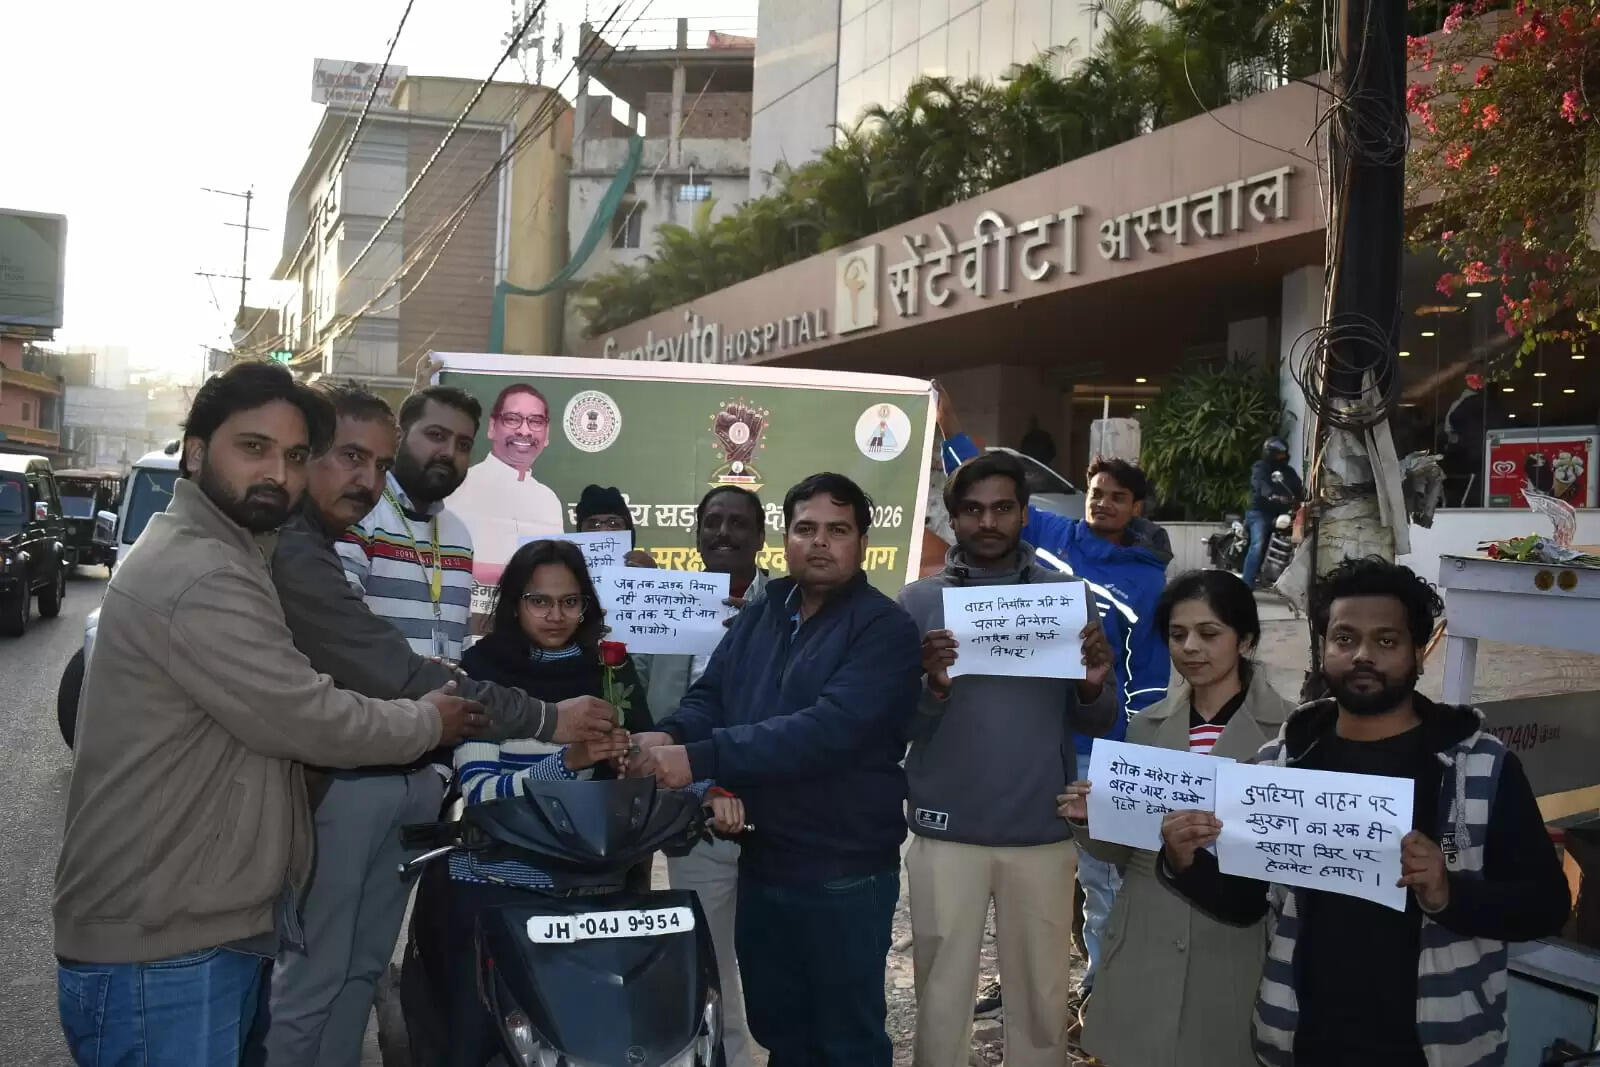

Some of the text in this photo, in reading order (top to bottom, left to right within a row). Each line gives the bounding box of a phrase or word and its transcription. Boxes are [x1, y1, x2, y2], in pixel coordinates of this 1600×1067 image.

[887, 165, 1297, 317] सेंटेवीटा अस्पताल
[724, 308, 831, 362] HOSPITAL
[637, 609, 659, 621] तक
[964, 600, 994, 613] वाहन
[1109, 754, 1141, 777] शोक
[1314, 792, 1362, 811] वाहन
[1368, 796, 1398, 816] पर
[1246, 813, 1393, 842] सुरक्षा का एक ही
[1255, 842, 1381, 863] सहारा सिर पर
[1265, 857, 1312, 875] हेलमेट
[1319, 867, 1364, 883] हमारा
[543, 922, 571, 940] JH
